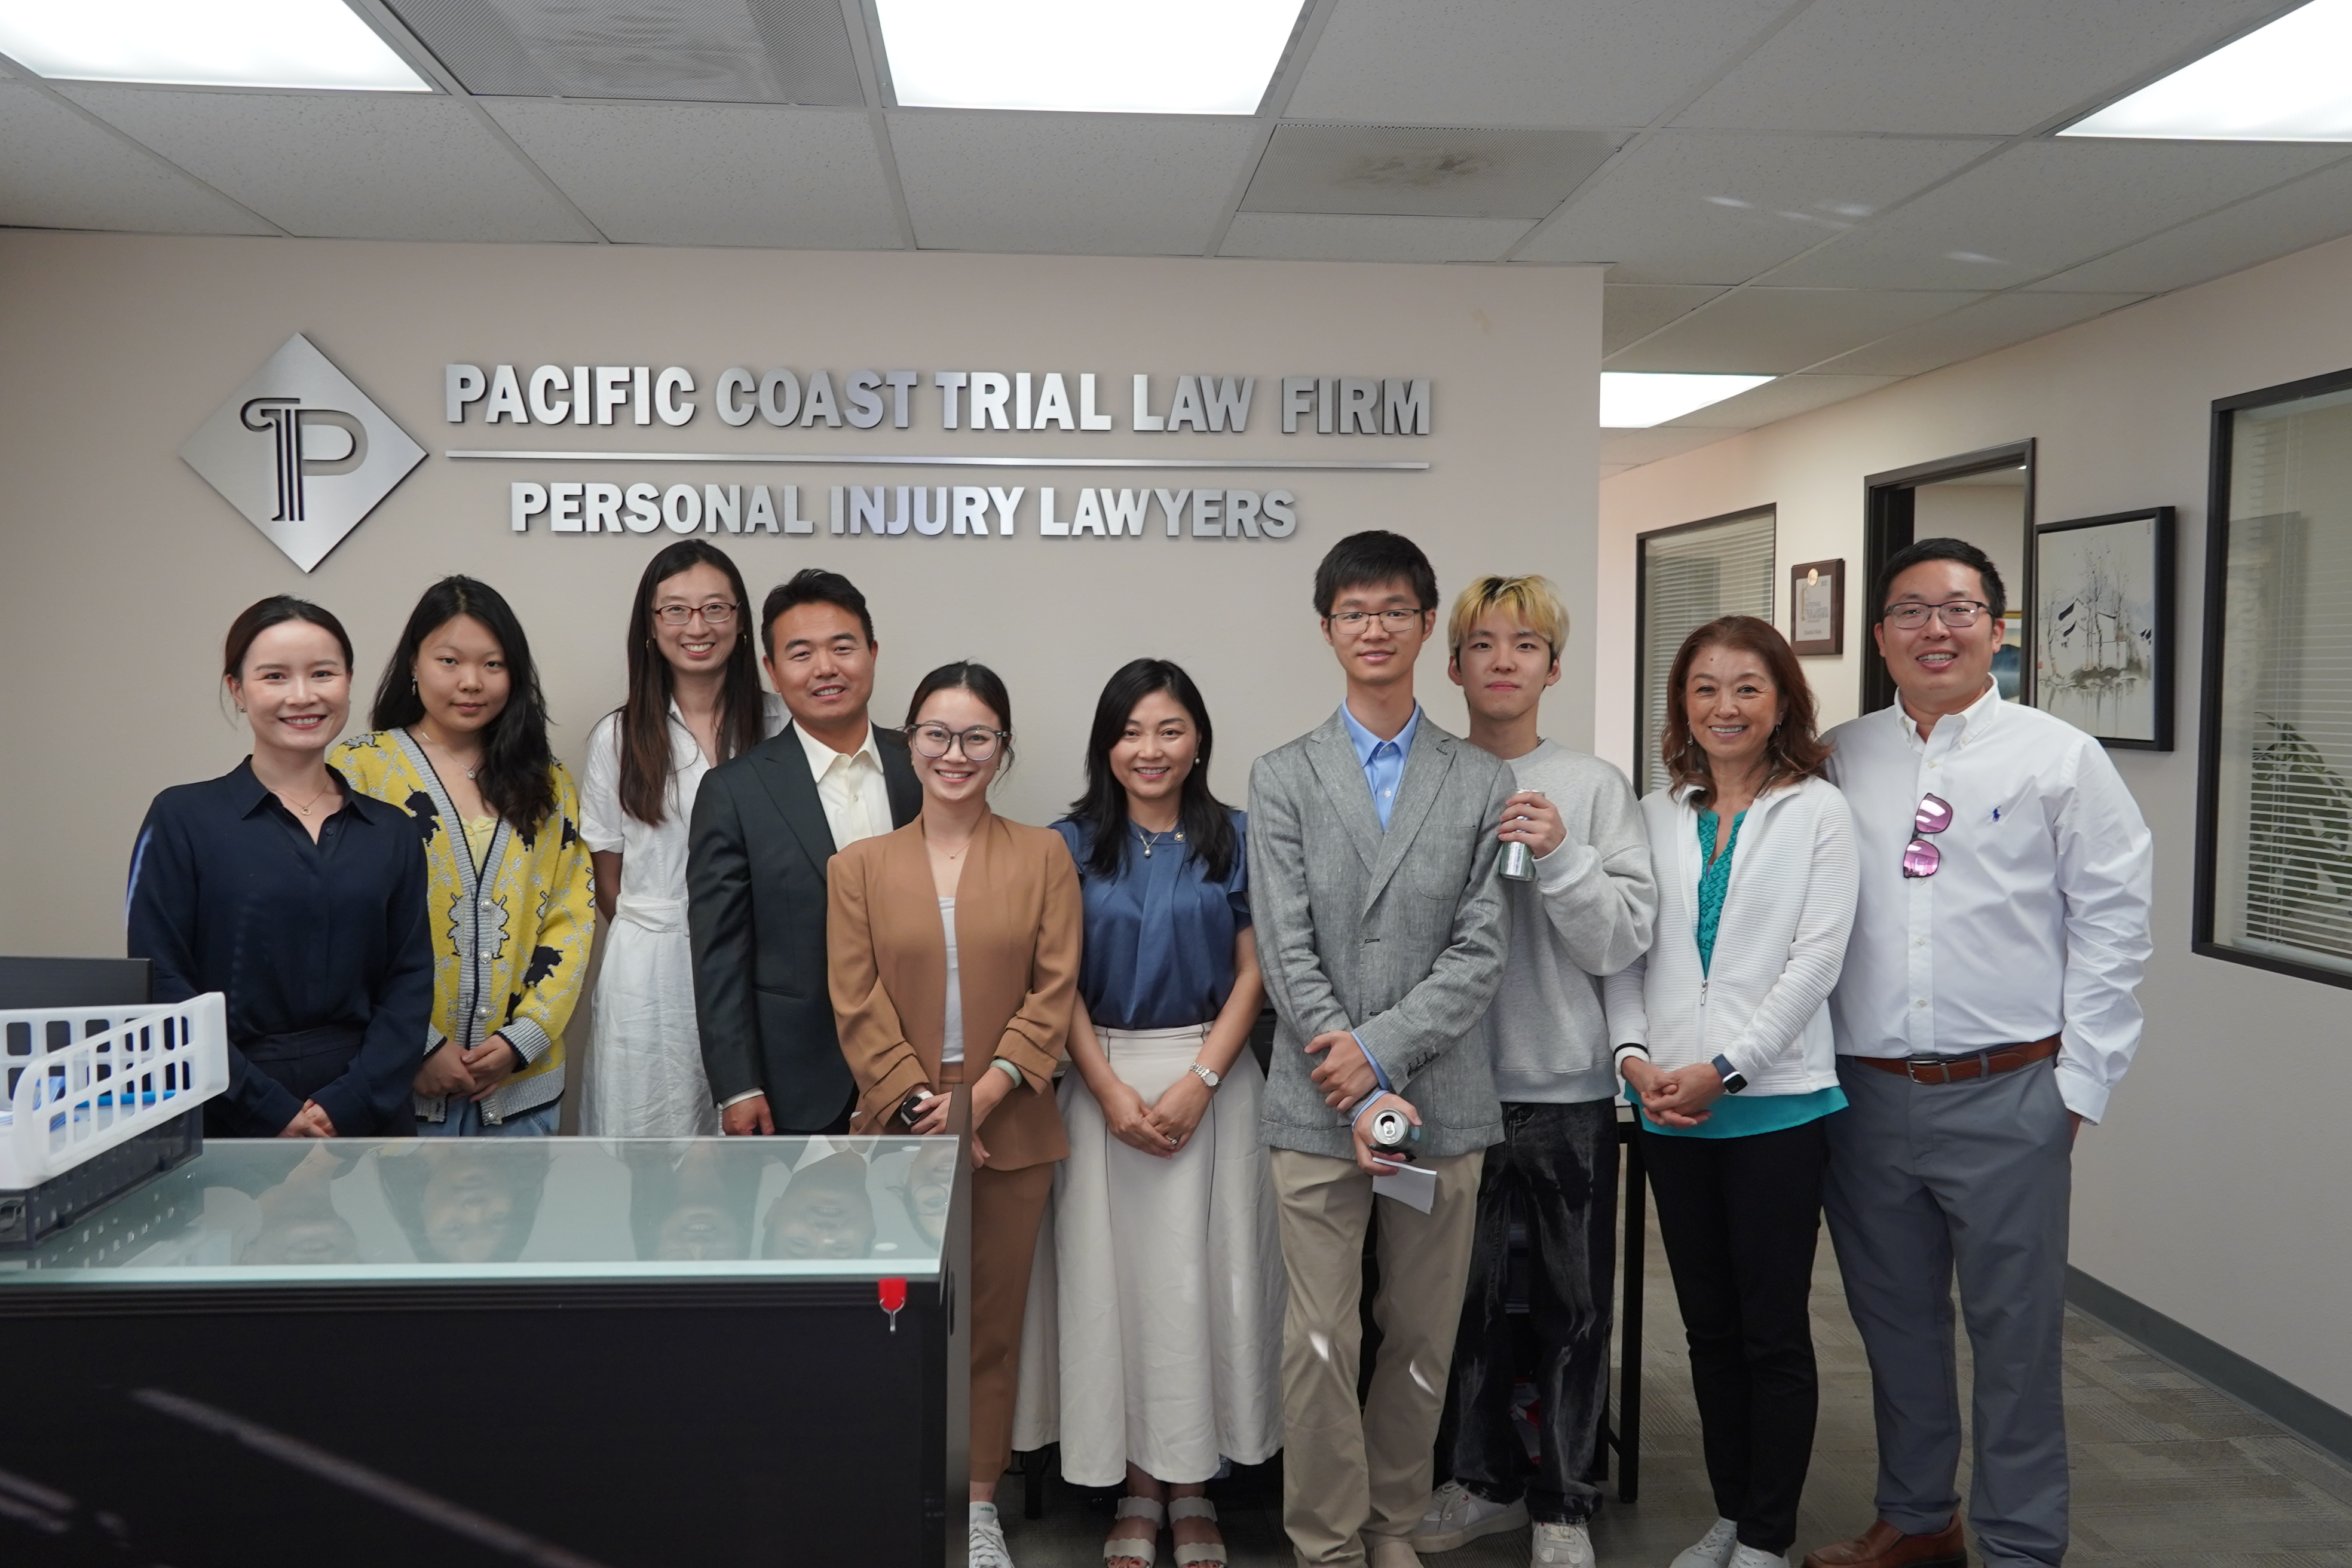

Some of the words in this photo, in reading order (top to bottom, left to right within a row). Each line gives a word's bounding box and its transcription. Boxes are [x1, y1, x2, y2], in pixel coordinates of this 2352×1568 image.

[445, 364, 696, 426] PACIFIC
[716, 367, 918, 428] COAST
[935, 371, 1111, 431] TRIAL
[1132, 373, 1255, 433] LAW
[1281, 376, 1431, 435] FIRM
[511, 482, 814, 534] PERSONAL
[830, 485, 1025, 537] INJURY
[1040, 487, 1297, 538] LAWYERS
